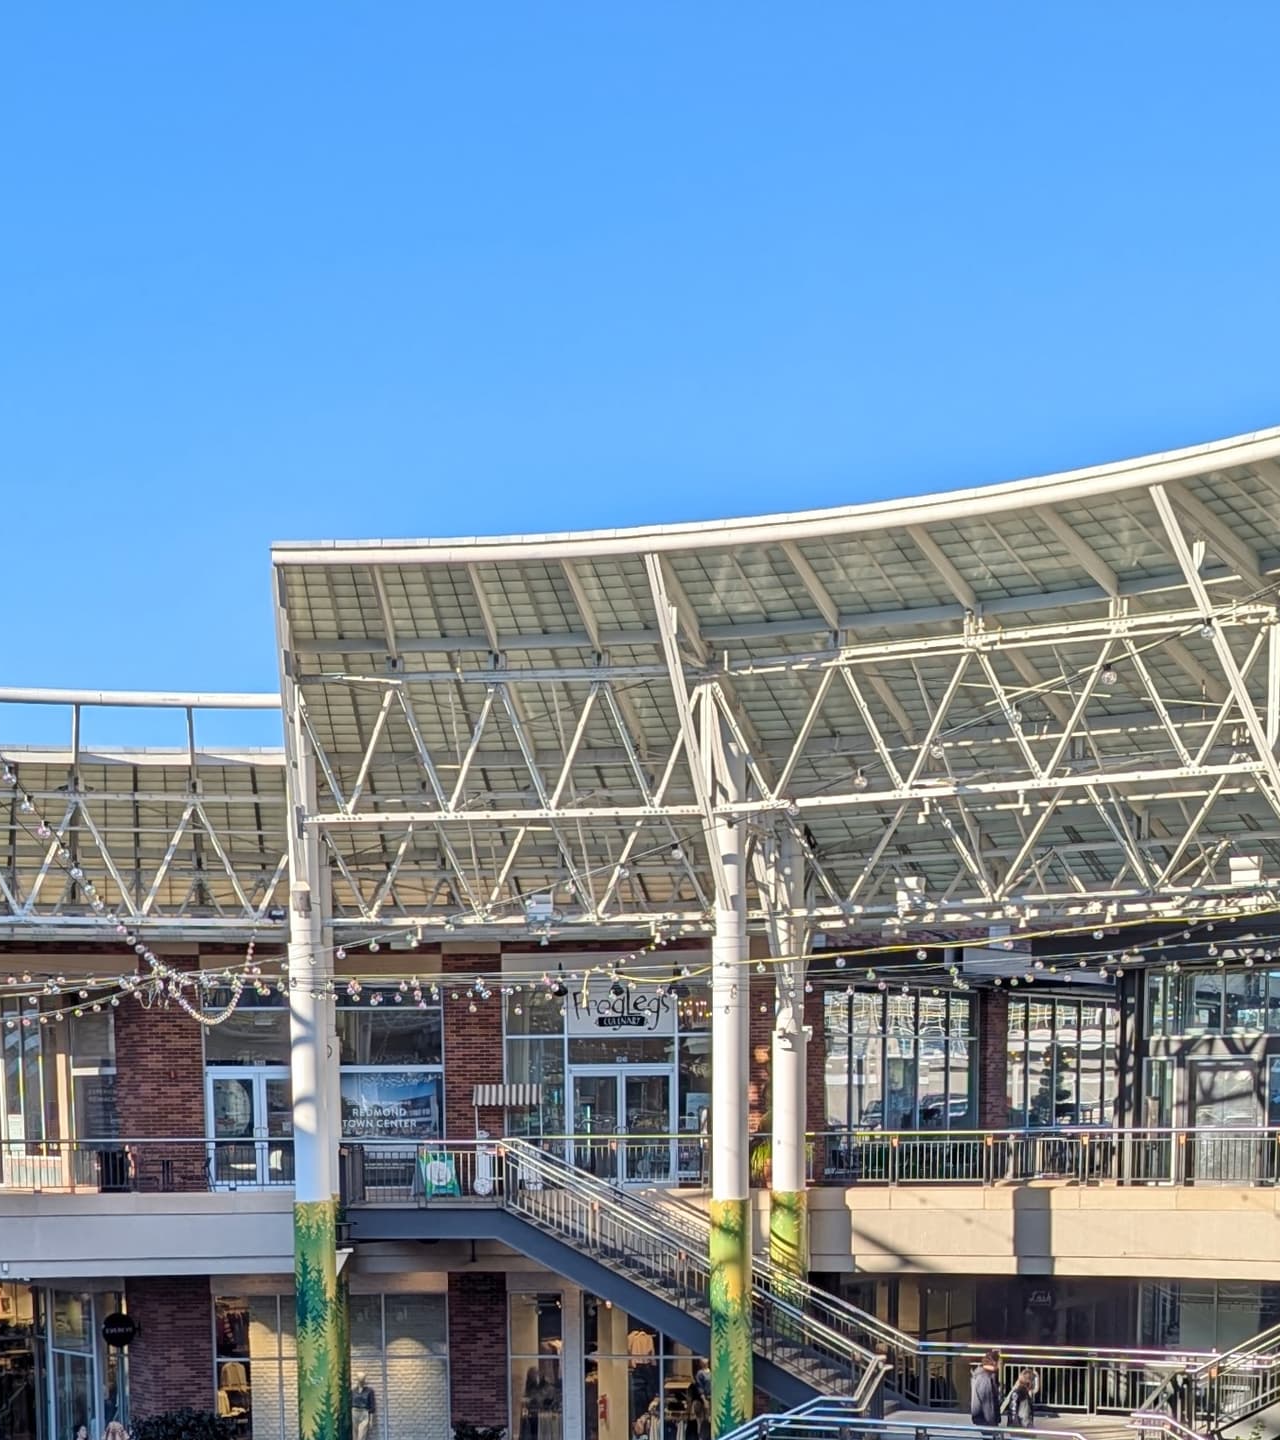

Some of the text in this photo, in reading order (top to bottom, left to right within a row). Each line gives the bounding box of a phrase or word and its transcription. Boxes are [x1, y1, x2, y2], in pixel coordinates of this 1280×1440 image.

[352, 1107, 408, 1117] REDMOND
[342, 1119, 418, 1128] TOWN CENTER
